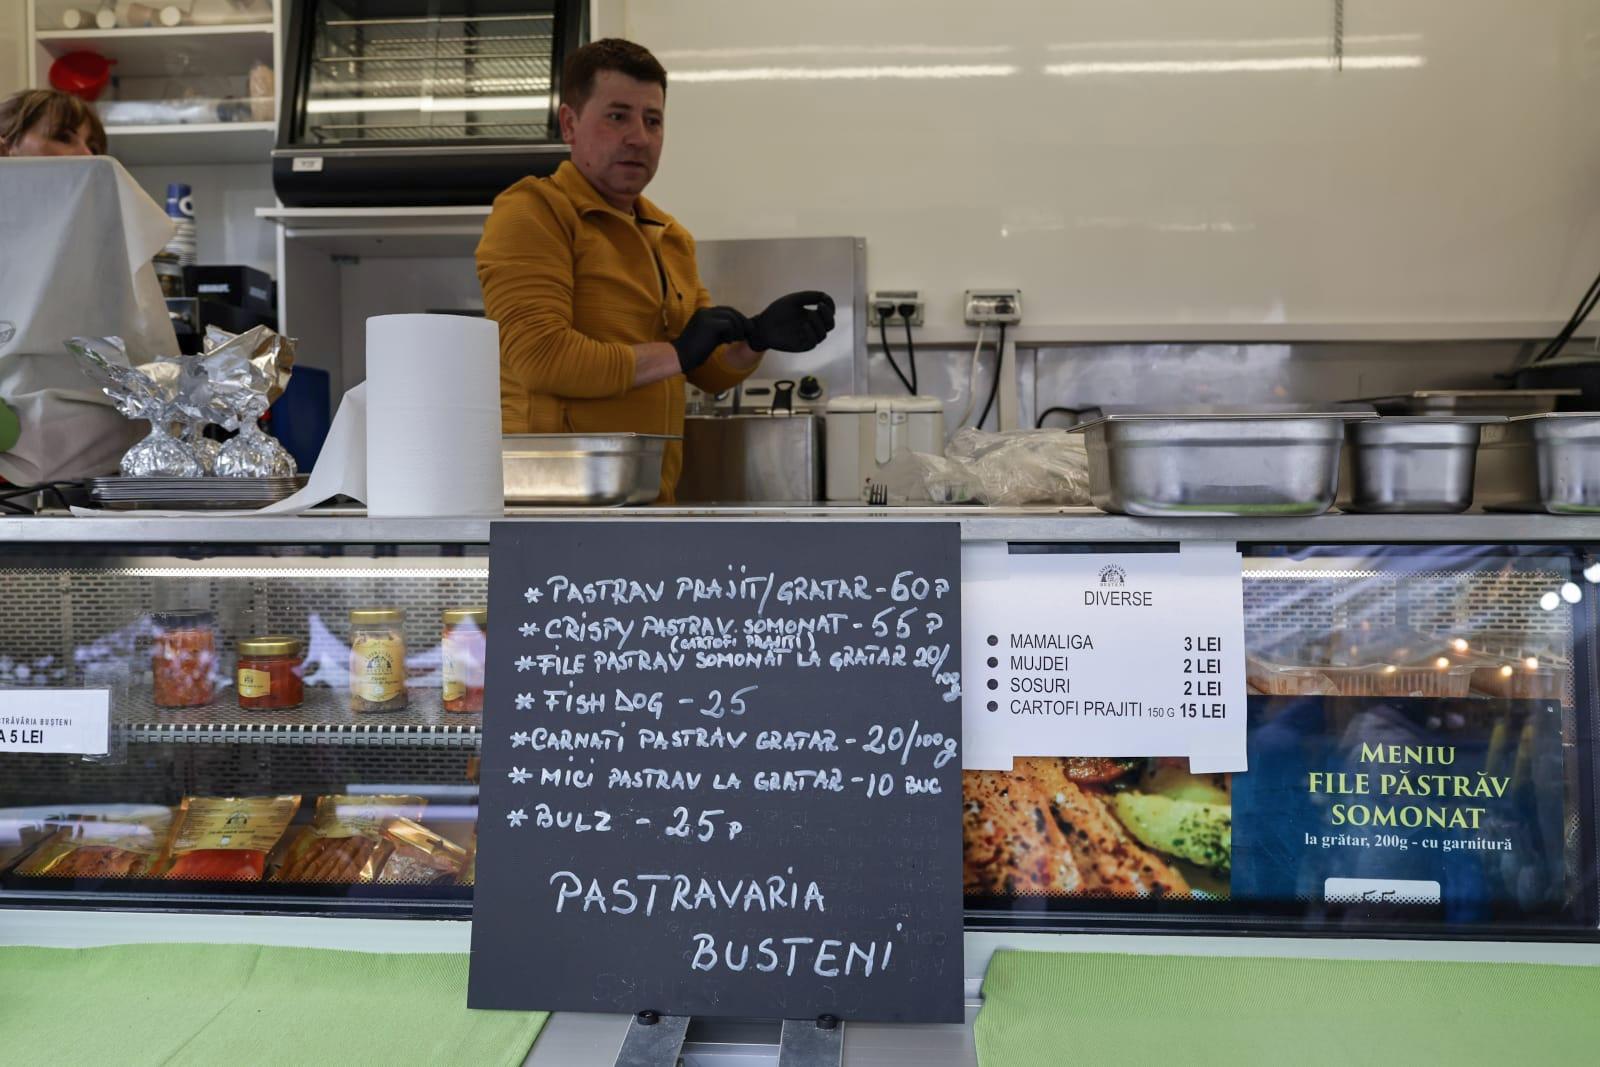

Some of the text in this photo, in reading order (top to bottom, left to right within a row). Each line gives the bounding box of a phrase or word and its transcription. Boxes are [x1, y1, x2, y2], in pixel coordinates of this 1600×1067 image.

[547, 575, 664, 606] PASTRAV
[1084, 591, 1152, 606] DIVERSE
[545, 610, 634, 650] CRISPY
[743, 612, 848, 636] SOMONAT
[1010, 634, 1222, 652] MAMALIGA 3 LEI
[536, 644, 586, 676] FILE
[594, 650, 685, 674] PASTRAV
[696, 648, 793, 669] SOMONAT
[797, 651, 821, 668] LA
[830, 645, 907, 672] GRATAR
[1010, 656, 1222, 674] MUJDEI 2 LEI
[1010, 678, 1222, 696] SOSURI 2 LEI
[543, 680, 605, 714] FISH
[615, 688, 663, 720] DOG
[700, 685, 758, 719] 25
[1010, 700, 1226, 719] CARTOFI PRAJITI 150 G 15 LEI
[0, 716, 37, 725] TRĂVĂRIA
[10, 729, 18, 743] 5
[22, 730, 43, 743] LEI
[531, 717, 626, 751] CARNATI
[639, 728, 747, 751] PASTRAV
[756, 729, 838, 752] GRATAR
[1360, 742, 1456, 765] MENIU
[609, 768, 701, 791] PASTRAV
[713, 772, 741, 790] LA
[754, 770, 844, 792] GRATAR
[905, 776, 941, 794] BUC
[1308, 770, 1512, 798] FILE PĂSTRĂV
[535, 803, 611, 832] BULZ
[1331, 804, 1486, 829] SOMONAT
[1304, 832, 1317, 846] la
[1321, 833, 1370, 848] grătar,
[1374, 834, 1408, 850] 200g
[1422, 838, 1439, 849] cu
[1442, 836, 1513, 851] garnitură
[549, 866, 825, 917] PASTRAVARIA
[692, 922, 903, 978] BUSTENI
